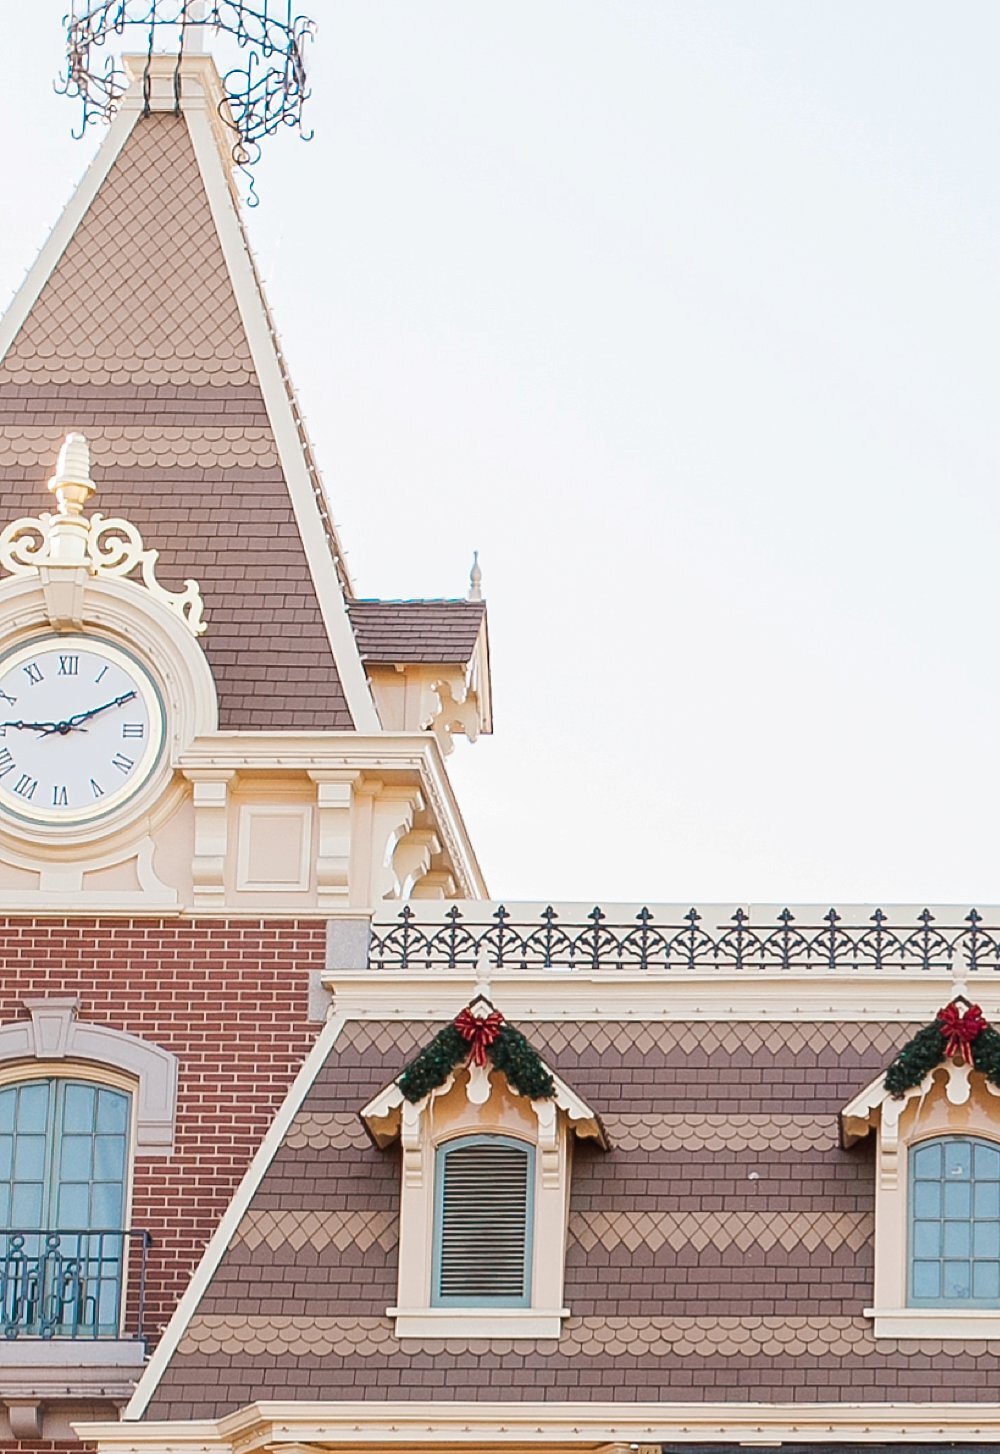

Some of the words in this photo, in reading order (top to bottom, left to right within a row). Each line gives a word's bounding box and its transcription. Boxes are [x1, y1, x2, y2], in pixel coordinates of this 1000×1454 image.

[23, 663, 44, 686] XI
[57, 655, 79, 675] XII
[122, 723, 144, 738] III
[13, 774, 38, 800] VII
[53, 786, 68, 806] VI
[90, 778, 105, 798] V
